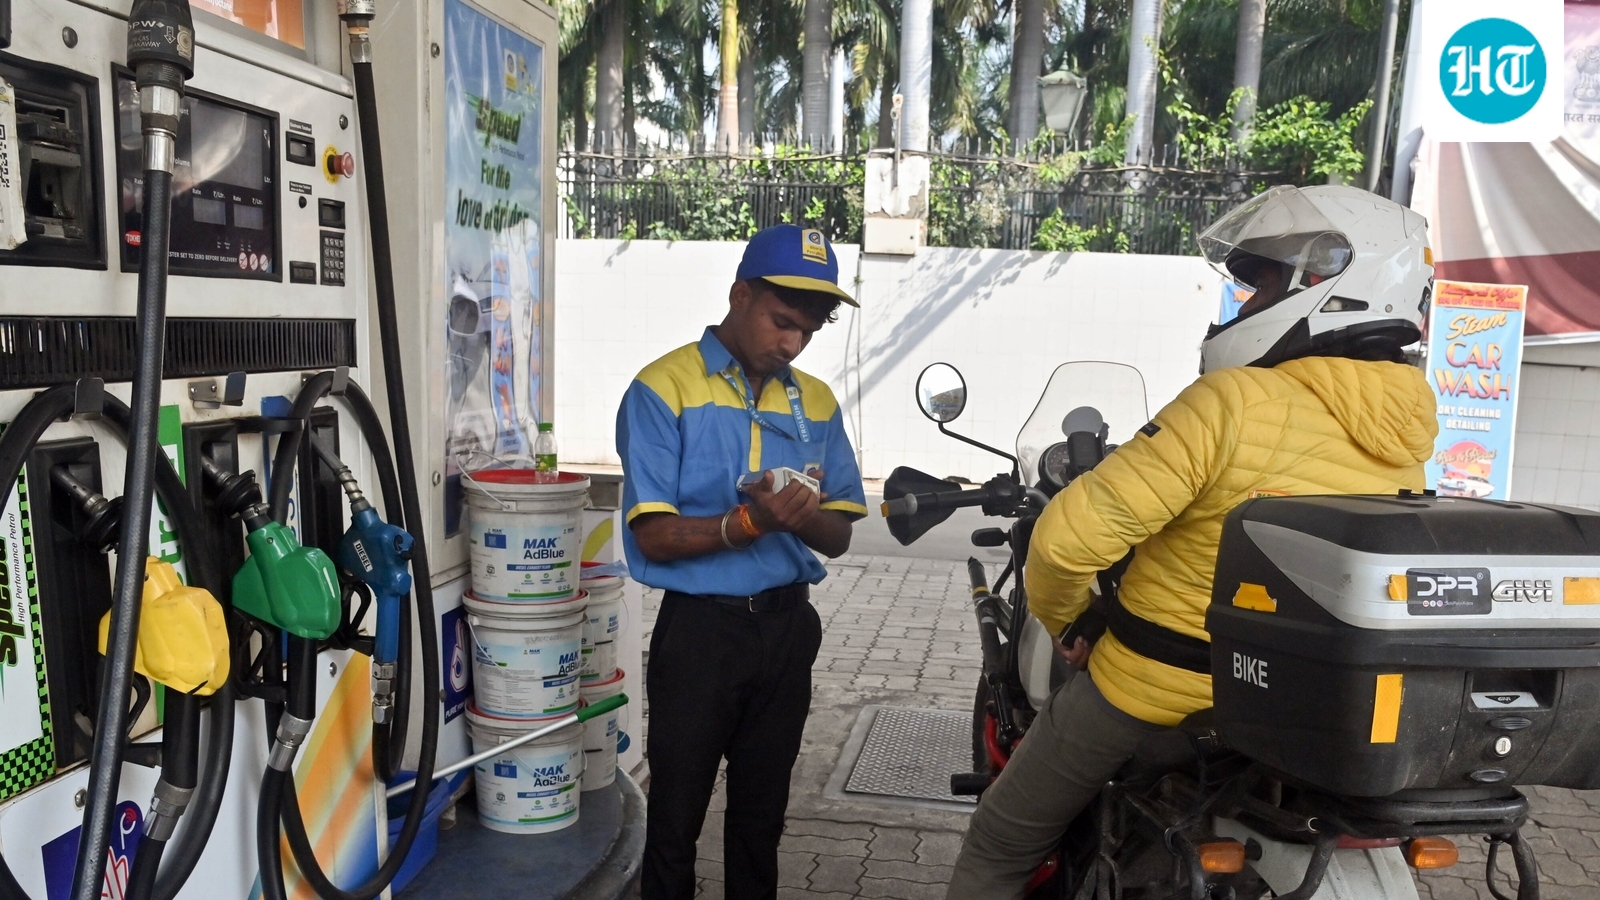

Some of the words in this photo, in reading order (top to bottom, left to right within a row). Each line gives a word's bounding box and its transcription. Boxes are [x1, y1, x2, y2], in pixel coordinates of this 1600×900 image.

[174, 157, 190, 167] olume
[481, 158, 495, 186] For
[496, 164, 510, 190] the
[455, 188, 483, 230] love
[205, 254, 220, 262] BEFORE
[1446, 311, 1507, 340] Steam
[1446, 340, 1502, 370] CAR
[1434, 368, 1512, 401] WASH
[1438, 405, 1456, 416] DRY
[1458, 406, 1501, 420] CLEANING
[793, 404, 810, 442] ETROLEUM
[1446, 418, 1490, 432] DETAILING
[9, 513, 17, 540] Petrol
[524, 538, 558, 549] MAK
[355, 543, 371, 570] DIESEL
[524, 549, 564, 560] AdBlue
[12, 542, 23, 600] Performance
[1416, 576, 1478, 596] DPR
[1491, 580, 1552, 602] GIVI
[18, 602, 26, 622] High
[558, 650, 579, 665] MAK
[558, 661, 580, 675] AdBlu
[1233, 652, 1268, 688] BIKE
[534, 764, 564, 778] MAK
[534, 774, 570, 788] AdBlue
